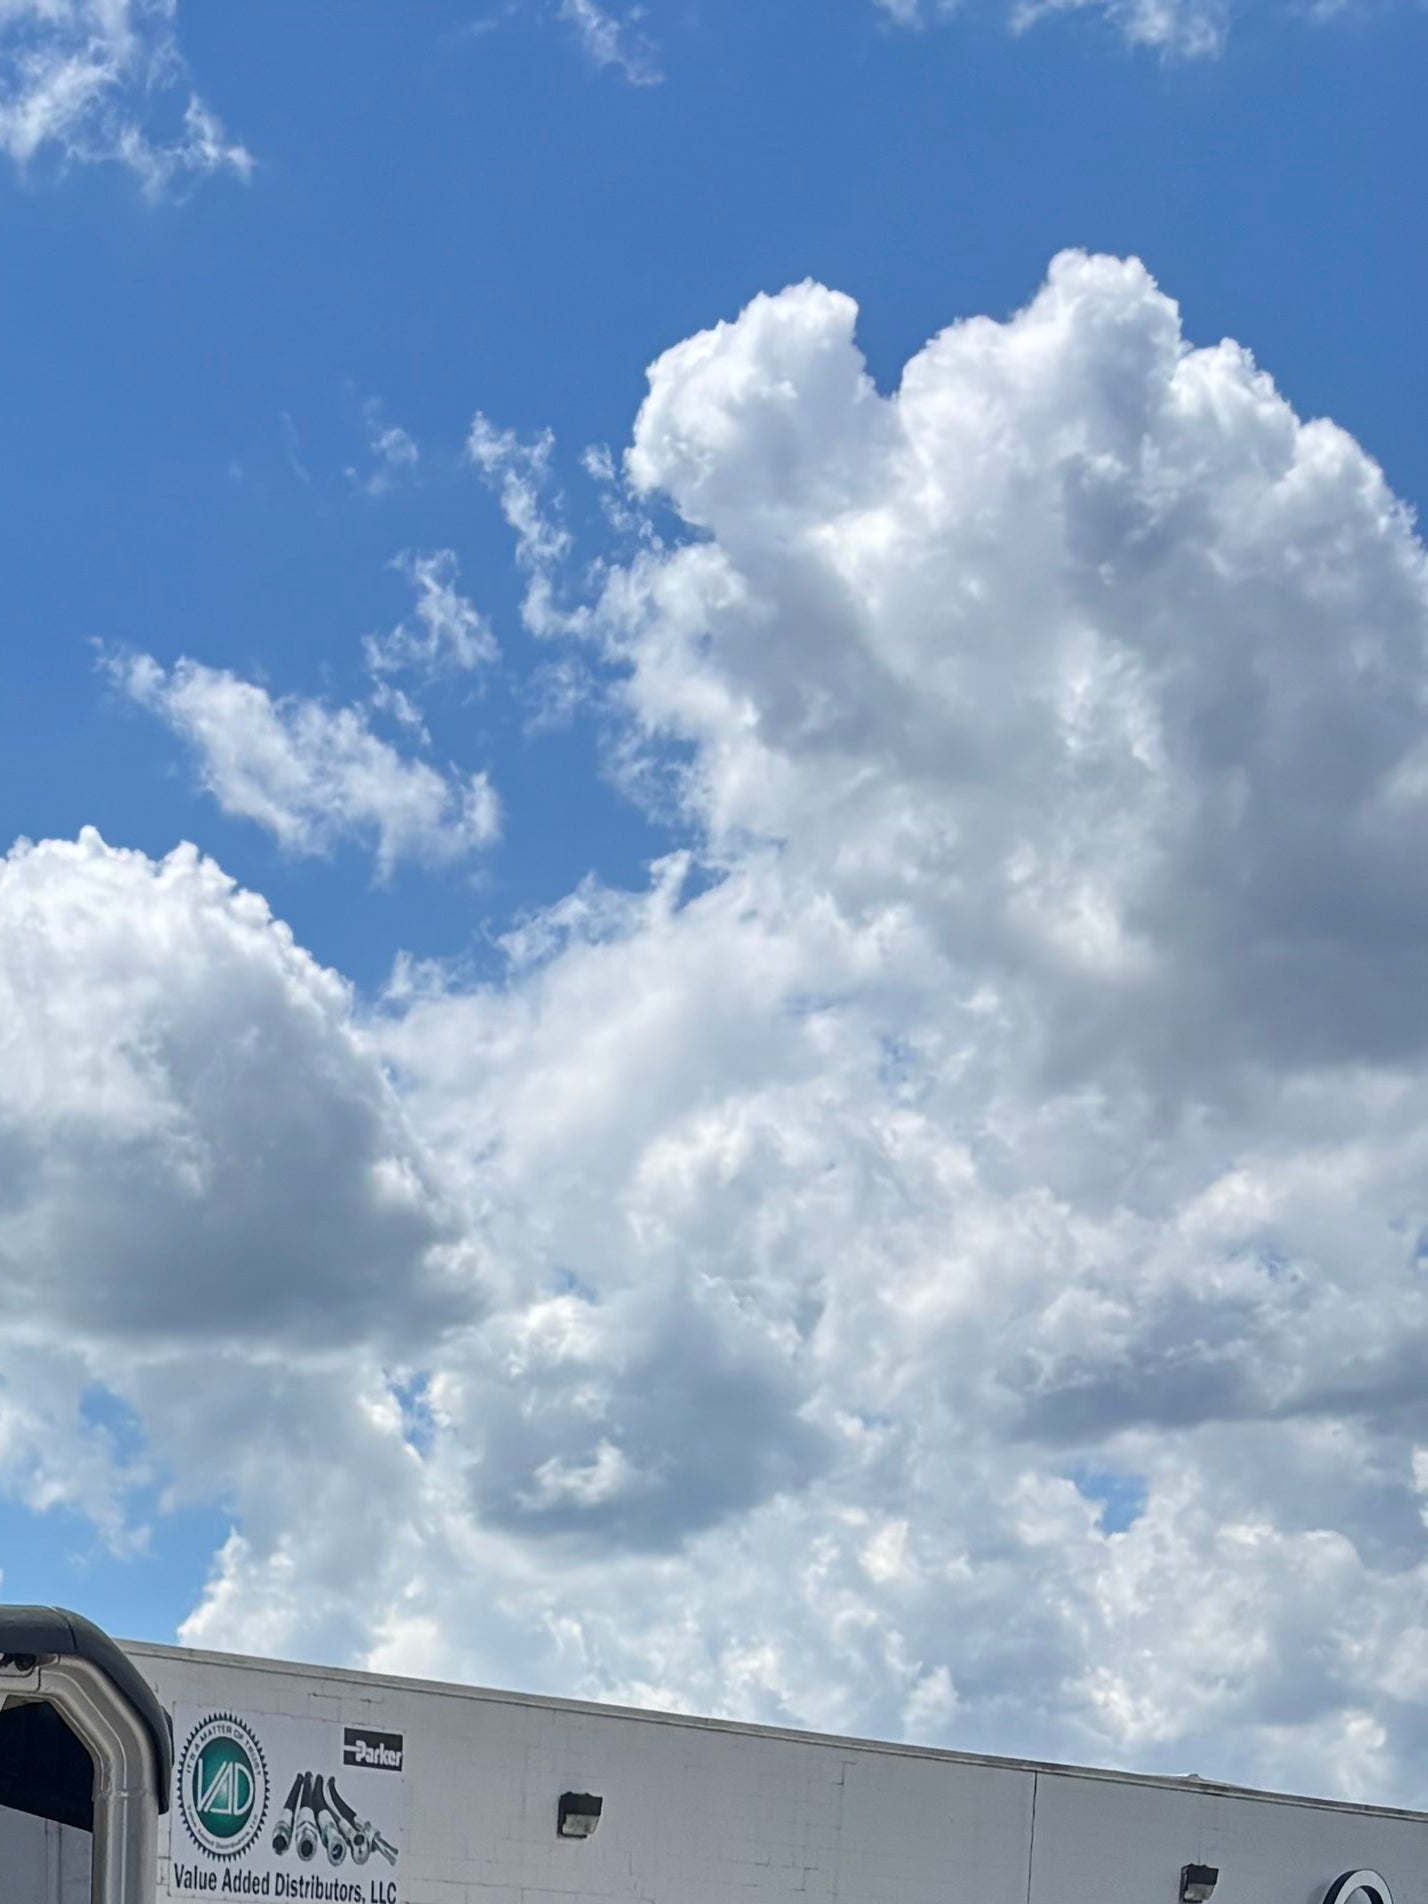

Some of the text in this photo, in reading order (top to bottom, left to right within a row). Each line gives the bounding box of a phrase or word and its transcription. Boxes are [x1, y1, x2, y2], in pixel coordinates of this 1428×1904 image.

[355, 1740, 402, 1767] Parker
[174, 1863, 217, 1891] Value
[221, 1867, 270, 1896] Added
[371, 1880, 397, 1904] LLC
